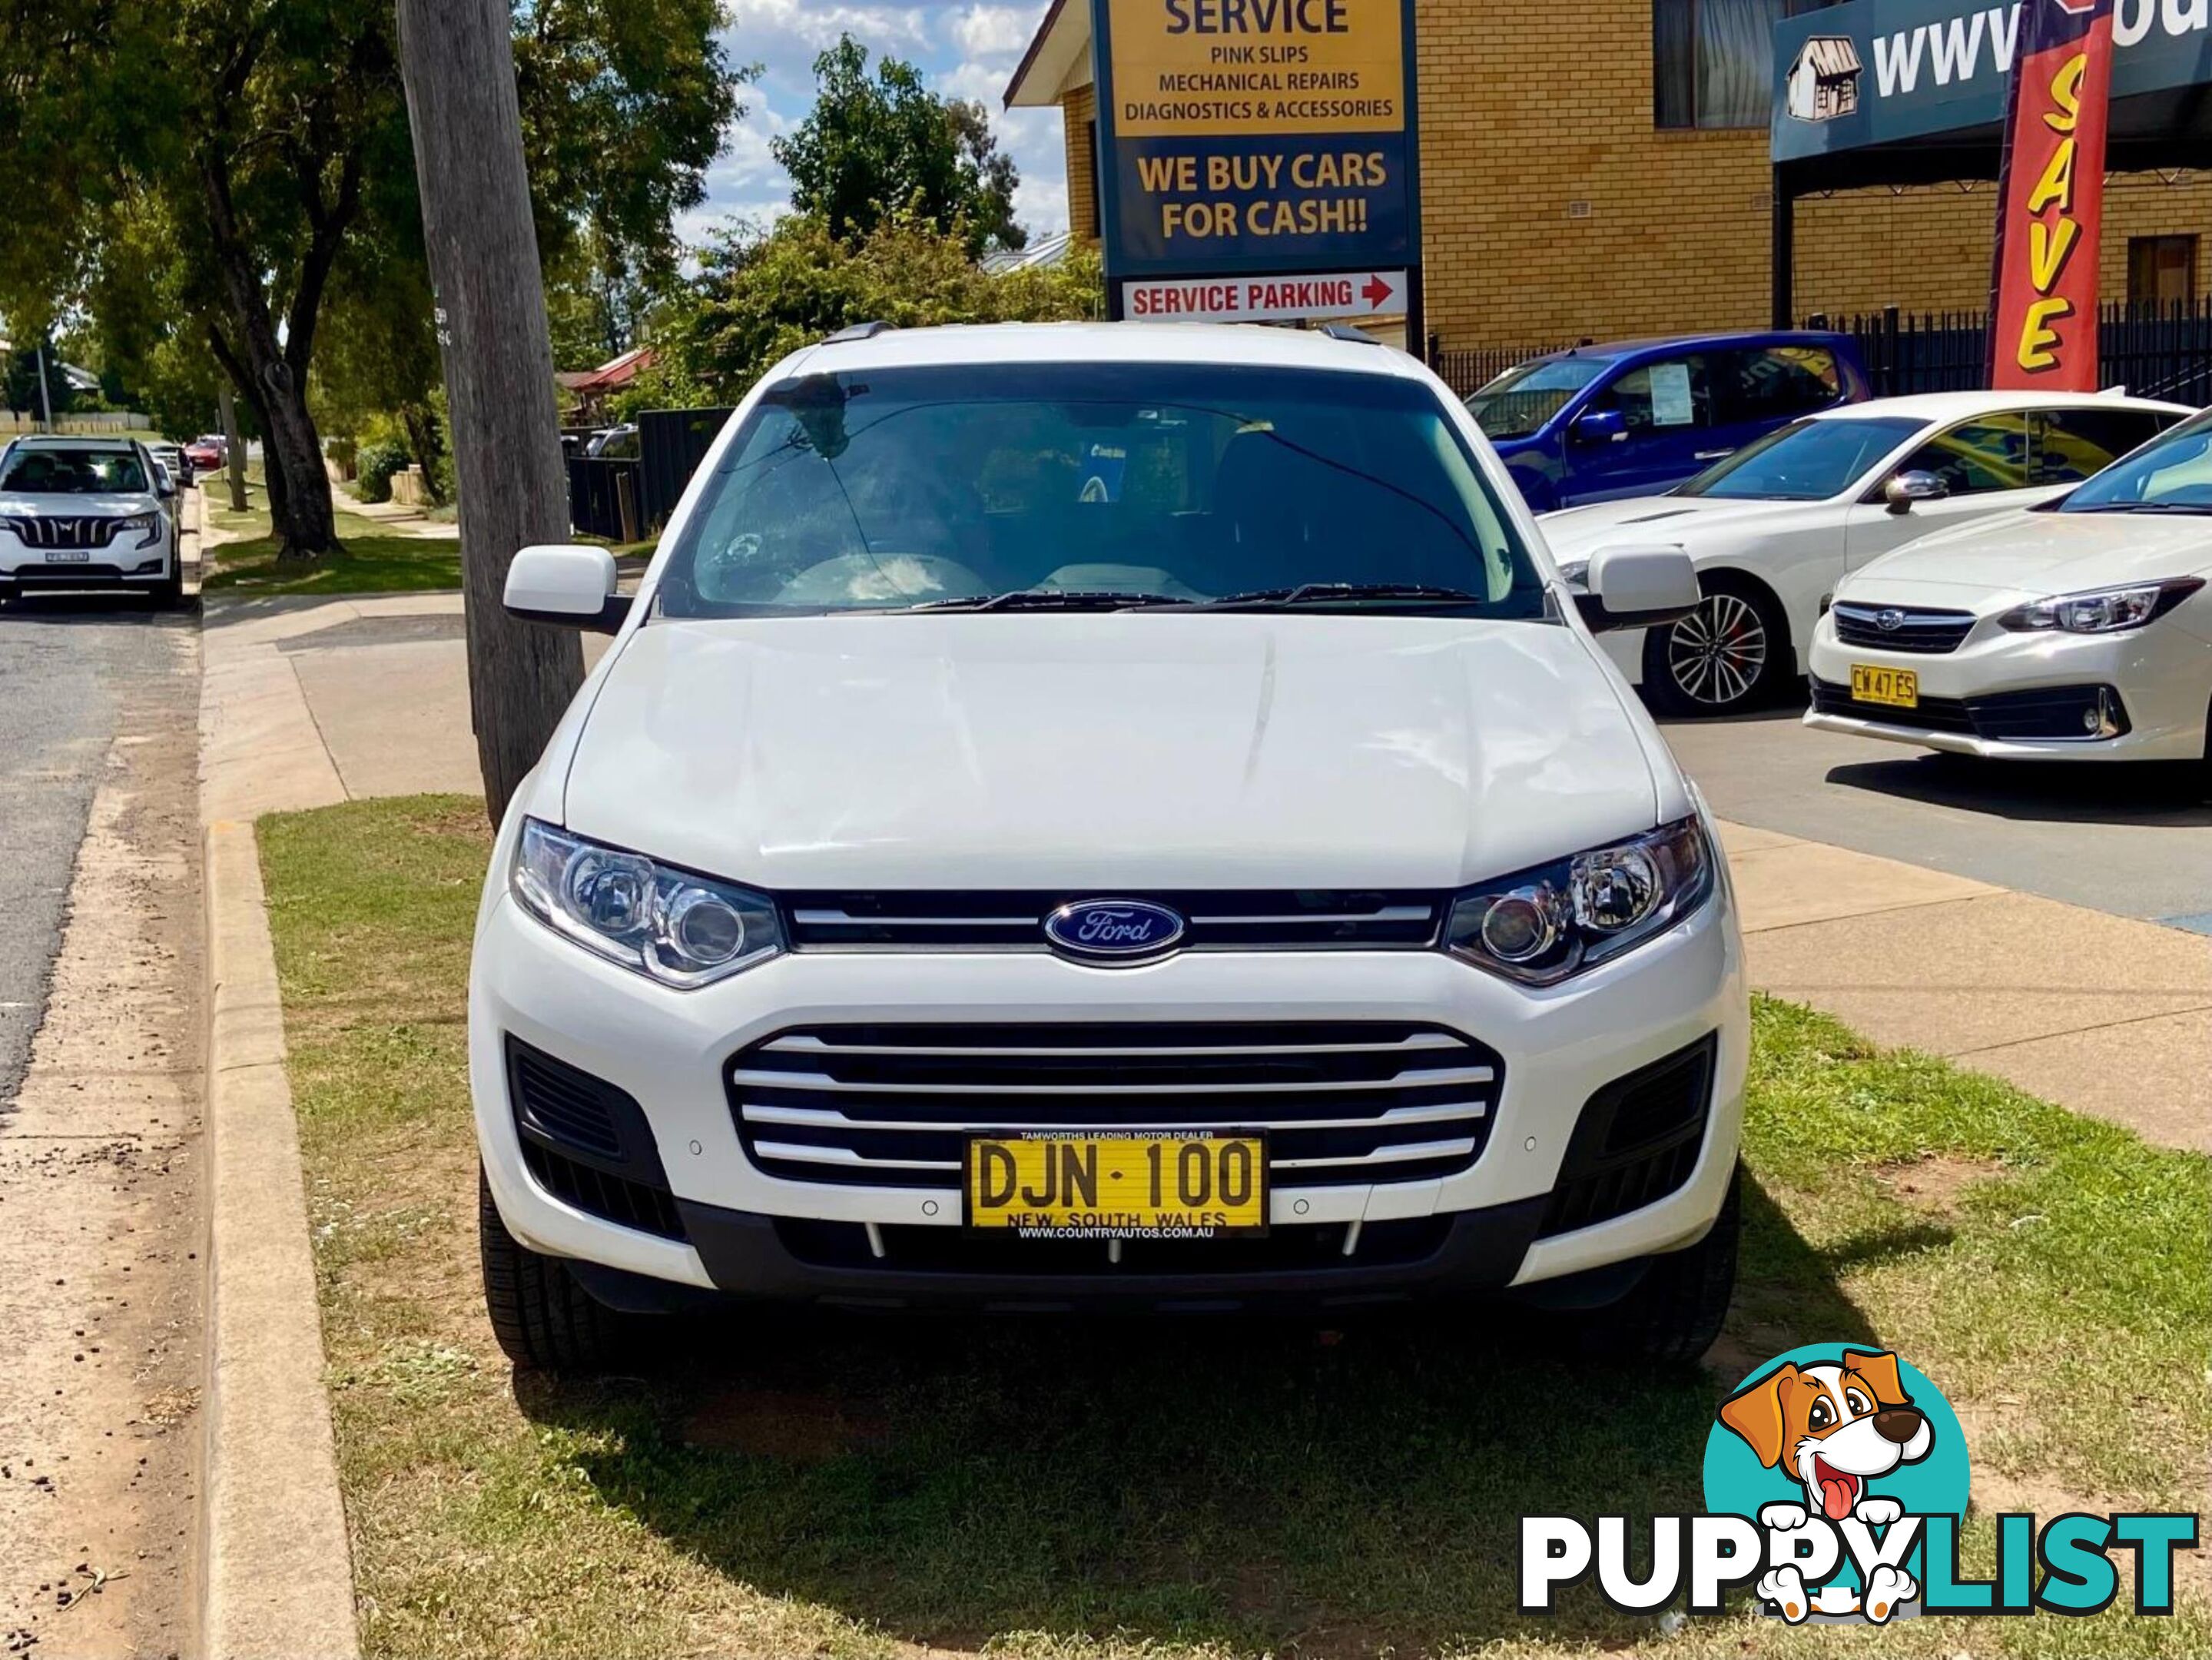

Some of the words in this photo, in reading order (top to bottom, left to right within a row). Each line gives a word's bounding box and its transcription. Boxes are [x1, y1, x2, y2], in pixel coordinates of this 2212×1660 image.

[1166, 0, 1349, 34] SERVICE
[1211, 46, 1255, 64] PINK
[1259, 45, 1308, 63] SLIPS
[1159, 73, 1282, 92] MECHANICAL
[1287, 72, 1360, 91] REPAIRS
[1125, 101, 1252, 121] DIAGNOSTICS
[1256, 102, 1270, 119] &
[1275, 99, 1393, 118] ACCESSORIES
[1137, 156, 1196, 192] WE
[1207, 154, 1283, 191] BUY
[1291, 152, 1387, 188] CARS
[1162, 202, 1239, 238] FOR
[1246, 198, 1368, 237] CASH!!
[2017, 53, 2088, 370] SAVE
[1133, 285, 1239, 315] SERVICE
[1248, 280, 1353, 309] PARKING
[1078, 910, 1152, 941] Ford
[1020, 1131, 1086, 1141] TAMWORTHS
[1087, 1131, 1132, 1141] LEADING
[1134, 1131, 1172, 1140] MOTOR
[1173, 1130, 1214, 1140] DEALER
[1007, 1212, 1053, 1227] NEW
[1068, 1212, 1141, 1227] SOUTH
[1155, 1212, 1227, 1227] WALES
[1019, 1227, 1214, 1239] WWW.COUNTRYAUTOS.COM.AU
